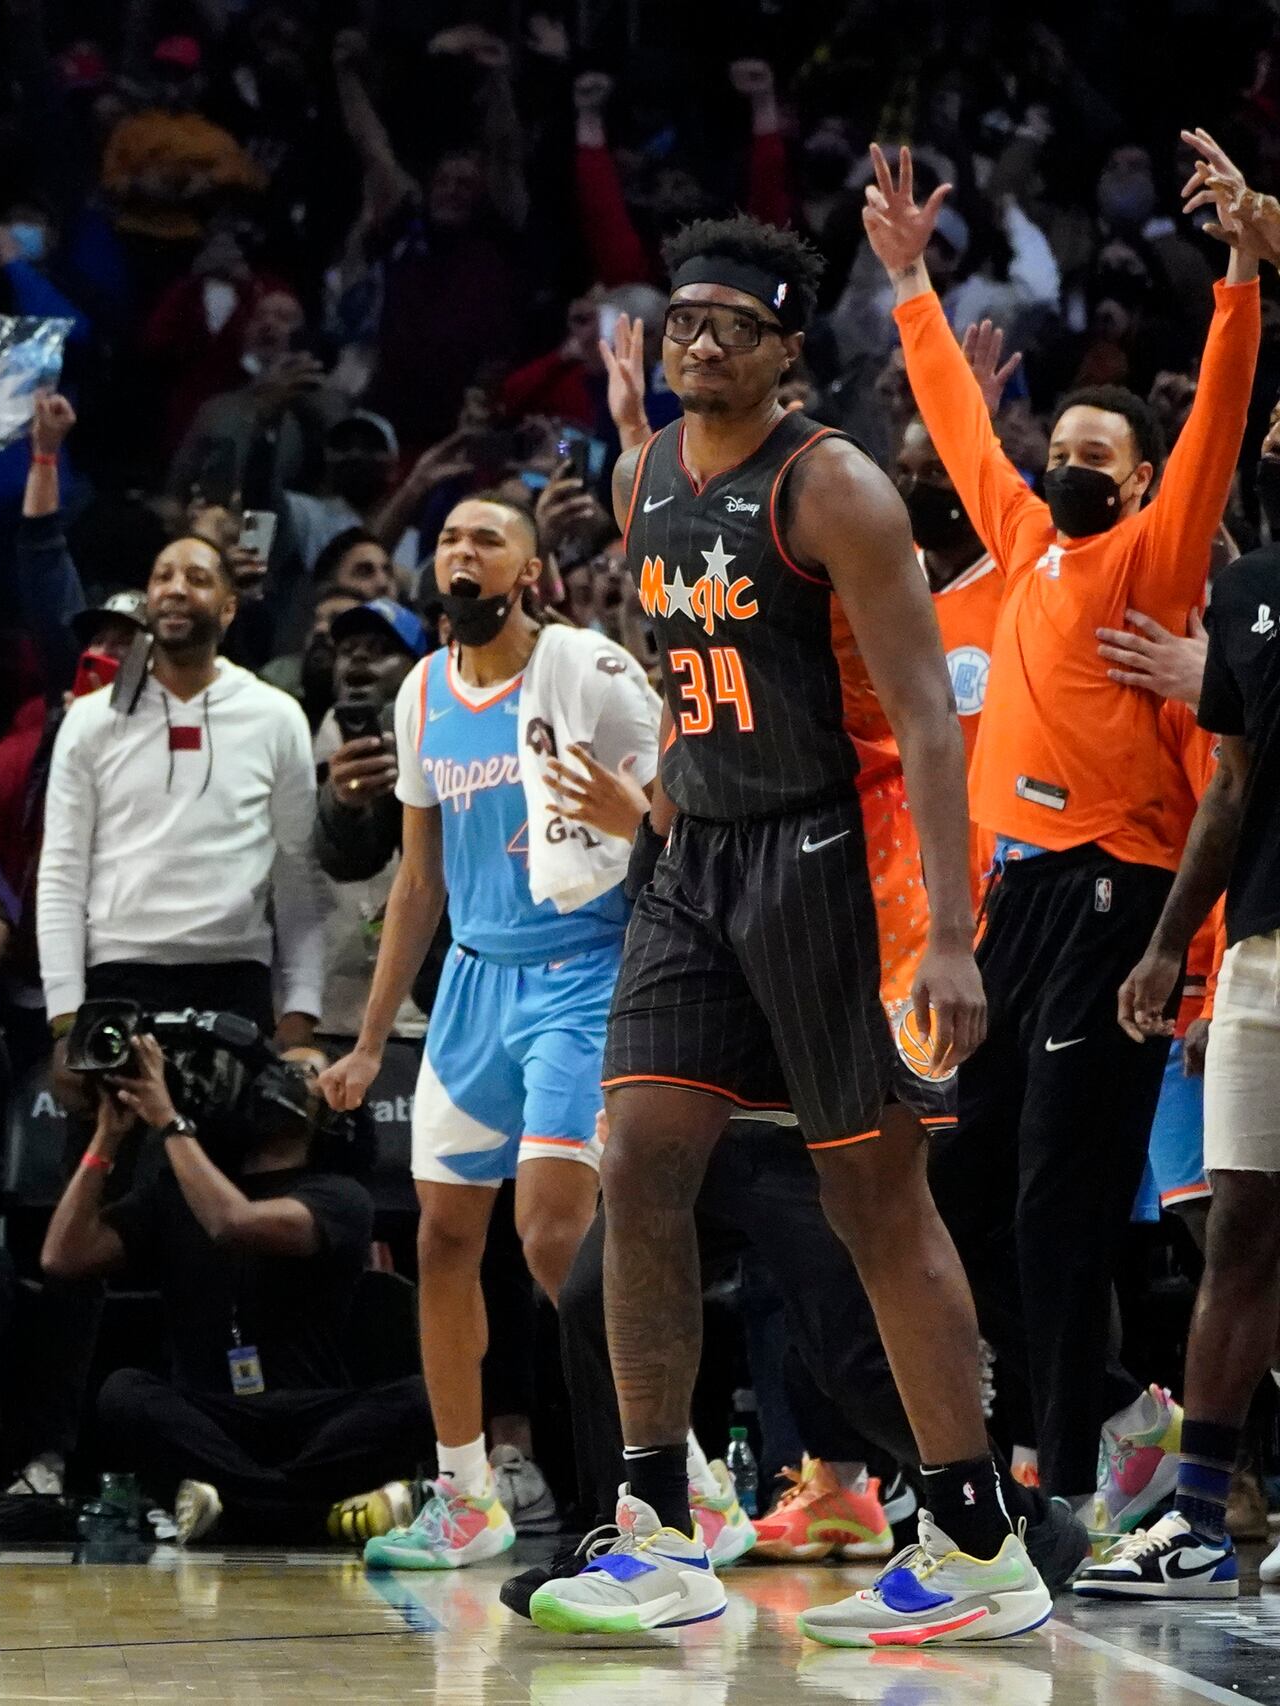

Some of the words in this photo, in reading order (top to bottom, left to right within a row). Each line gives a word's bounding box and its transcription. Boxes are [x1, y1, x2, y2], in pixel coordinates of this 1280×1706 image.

[724, 495, 760, 517] Disney
[669, 647, 754, 734] 34
[422, 755, 523, 813] lipper
